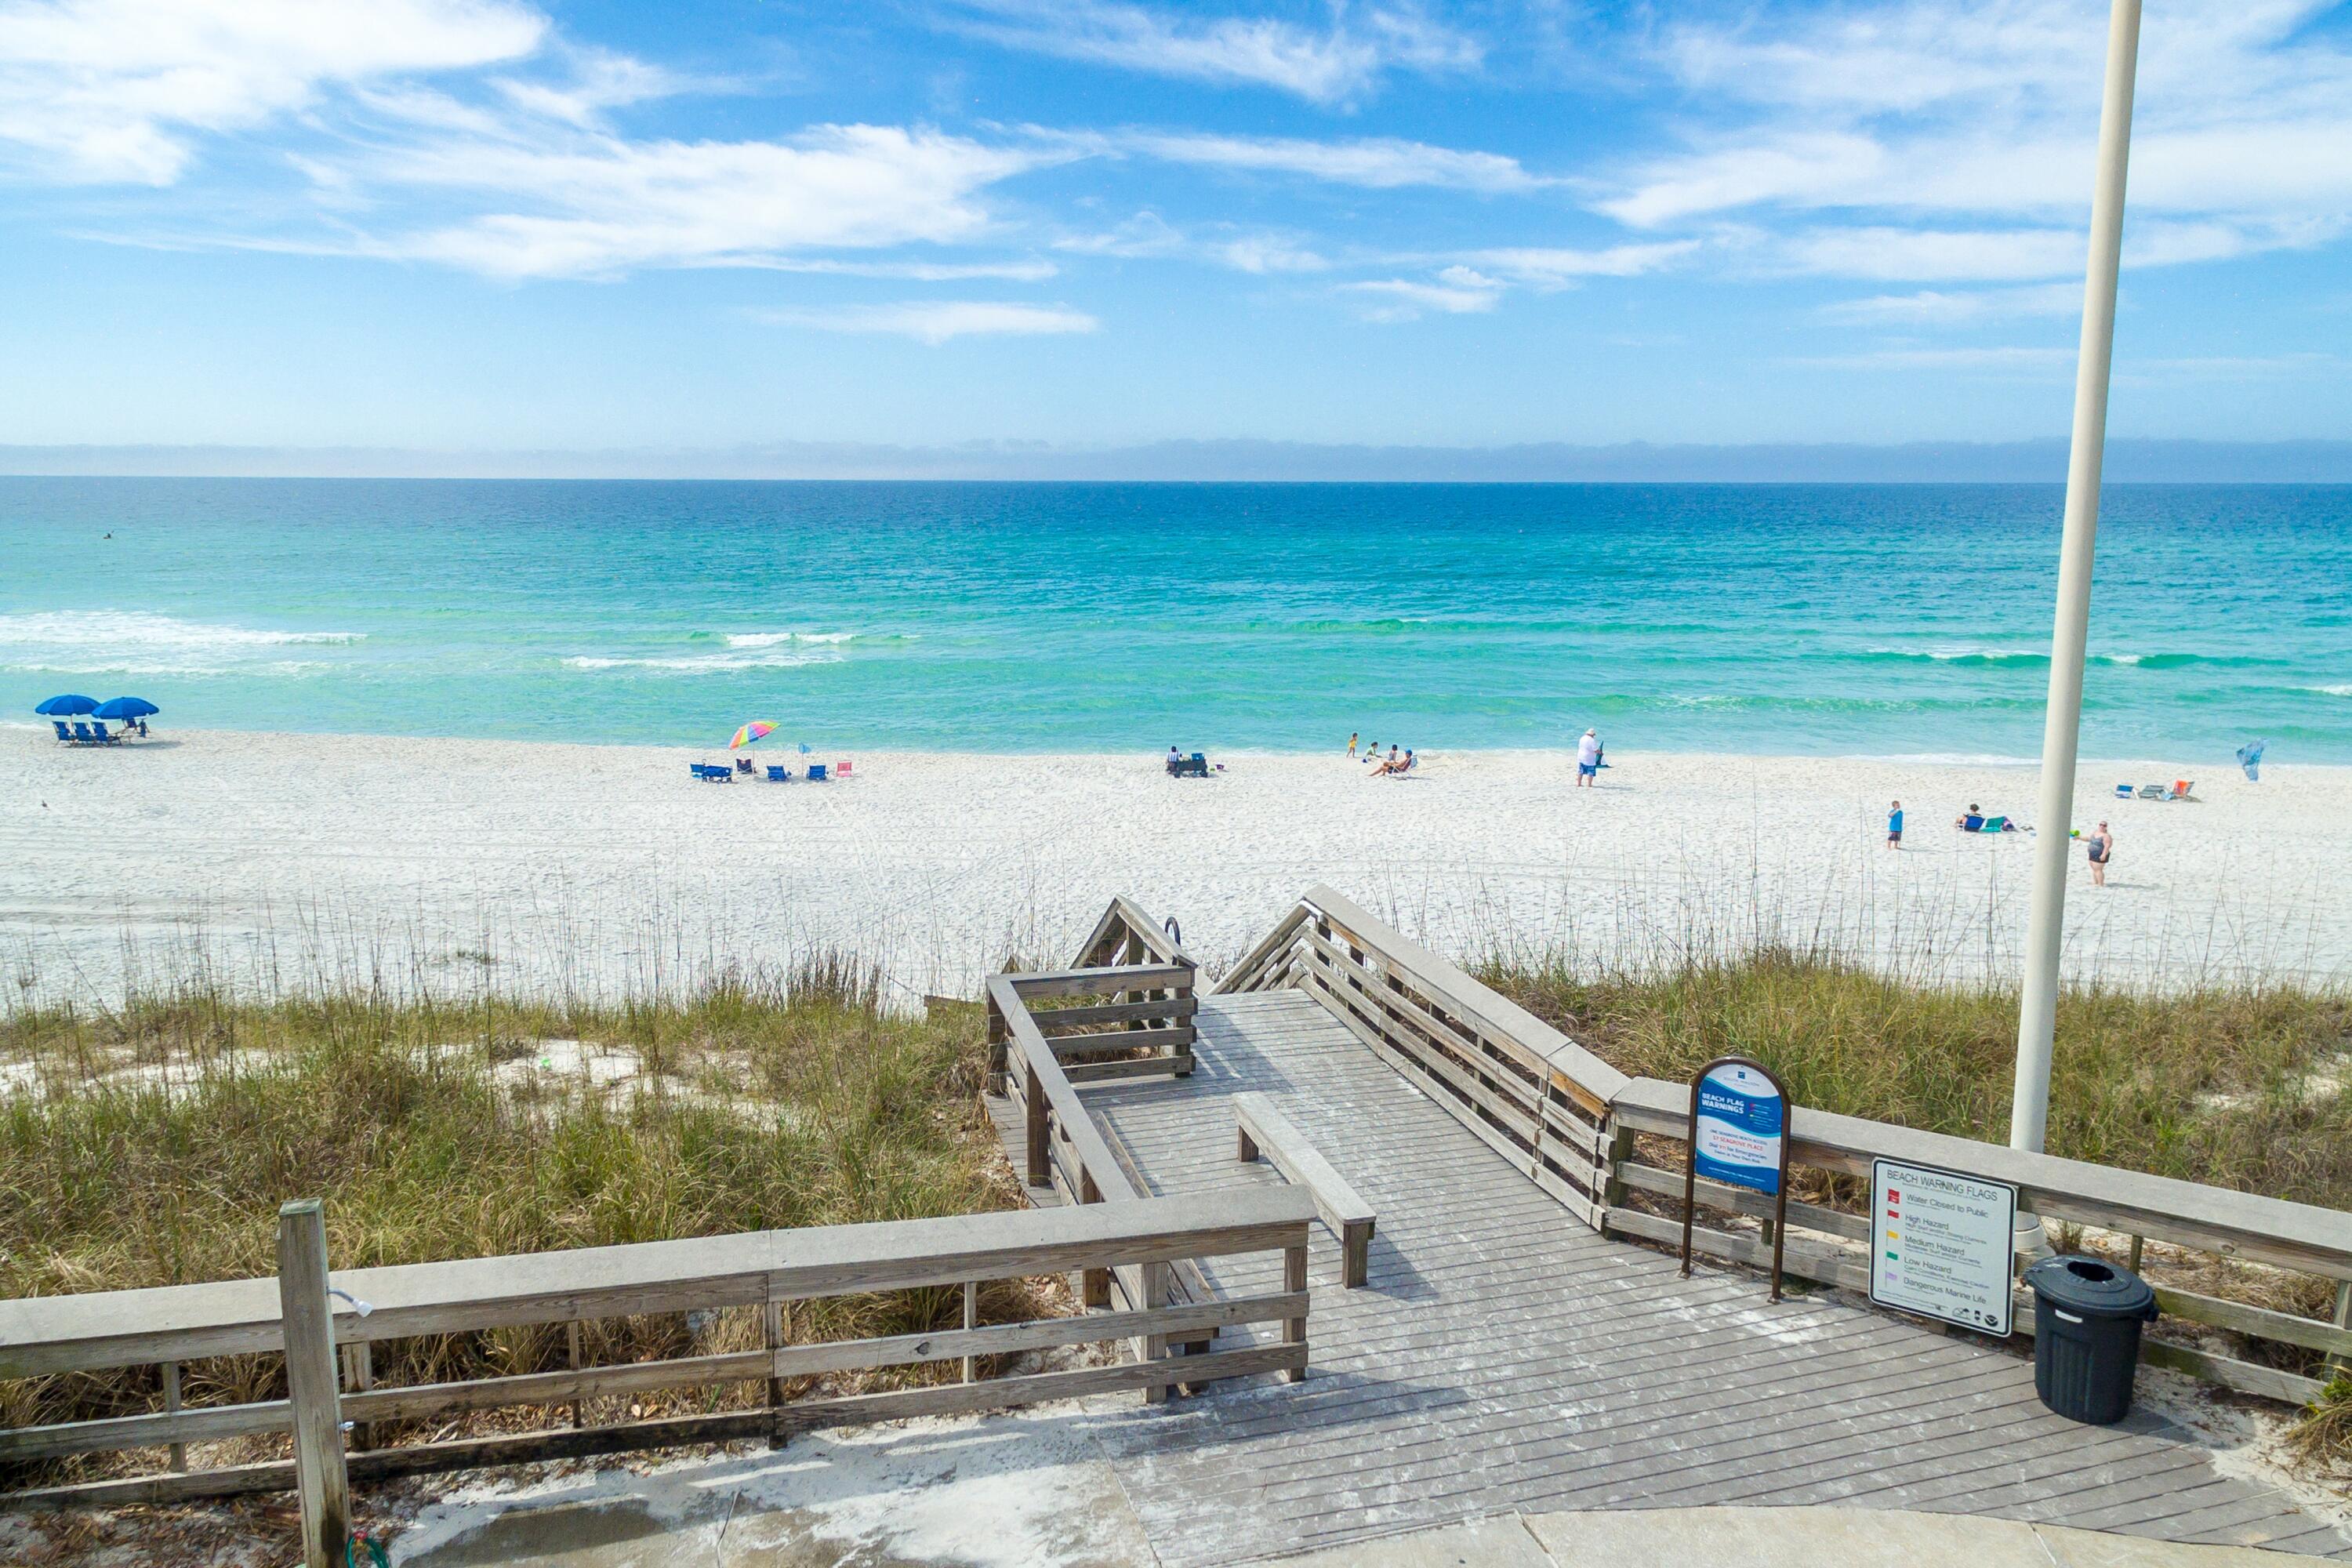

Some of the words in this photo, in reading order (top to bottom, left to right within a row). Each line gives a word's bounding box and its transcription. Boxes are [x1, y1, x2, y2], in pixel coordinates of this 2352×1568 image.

[1701, 1099, 1744, 1114] WARNINGS
[1702, 1093, 1724, 1102] BEACH
[1726, 1098, 1744, 1106] FLAG
[1720, 1137, 1745, 1147] SEAGROVE
[1887, 1169, 1918, 1184] BEACH
[1921, 1177, 1963, 1193] WARNING
[1966, 1186, 1998, 1201] FLAGS
[1907, 1193, 1927, 1204] Water
[1929, 1198, 1955, 1210] Closed
[1966, 1207, 1988, 1218] Public
[1905, 1214, 1920, 1225] High
[1923, 1218, 1949, 1230] Hazard
[1905, 1236, 1933, 1247] Medium
[1936, 1242, 1965, 1255] Hazard
[1904, 1257, 1920, 1265] Low
[1922, 1261, 1951, 1274] Hazard
[1904, 1277, 1943, 1293] Dangerous
[1945, 1287, 1971, 1301] Marine
[1973, 1294, 1987, 1304] Life
